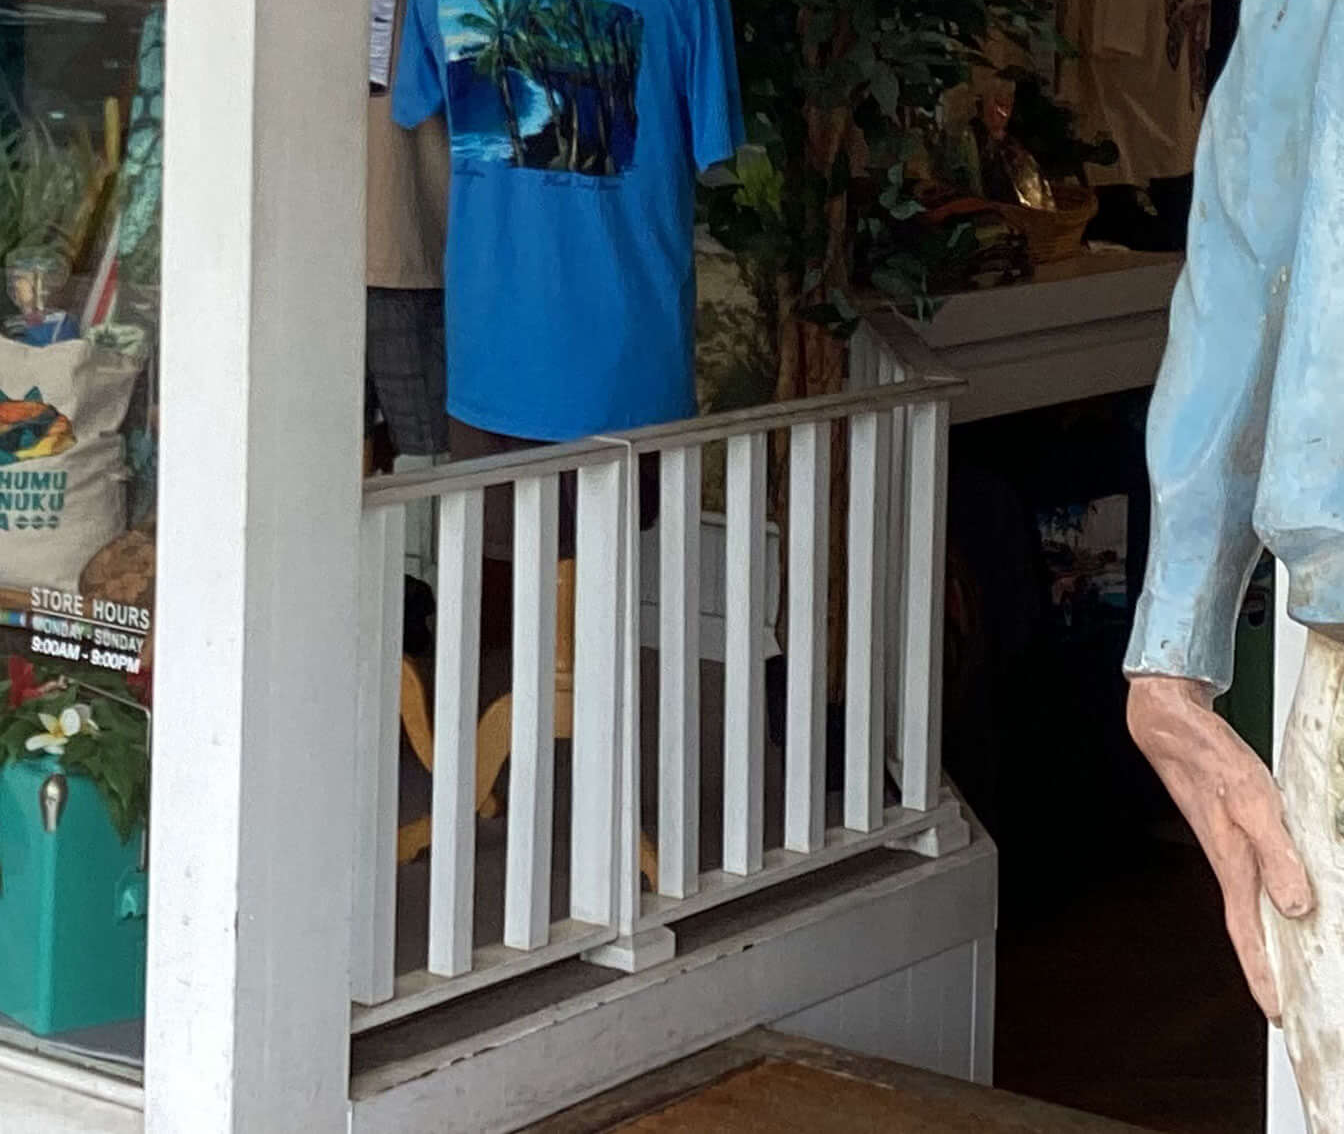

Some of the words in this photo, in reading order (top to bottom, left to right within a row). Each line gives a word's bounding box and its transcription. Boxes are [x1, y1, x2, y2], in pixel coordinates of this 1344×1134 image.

[31, 586, 83, 616] STORE
[92, 598, 150, 630] HOURS
[32, 615, 85, 641] MONDAY
[94, 627, 144, 653] SUNDAY
[31, 635, 80, 660] 9:00AM
[90, 649, 141, 674] 9:00PM
